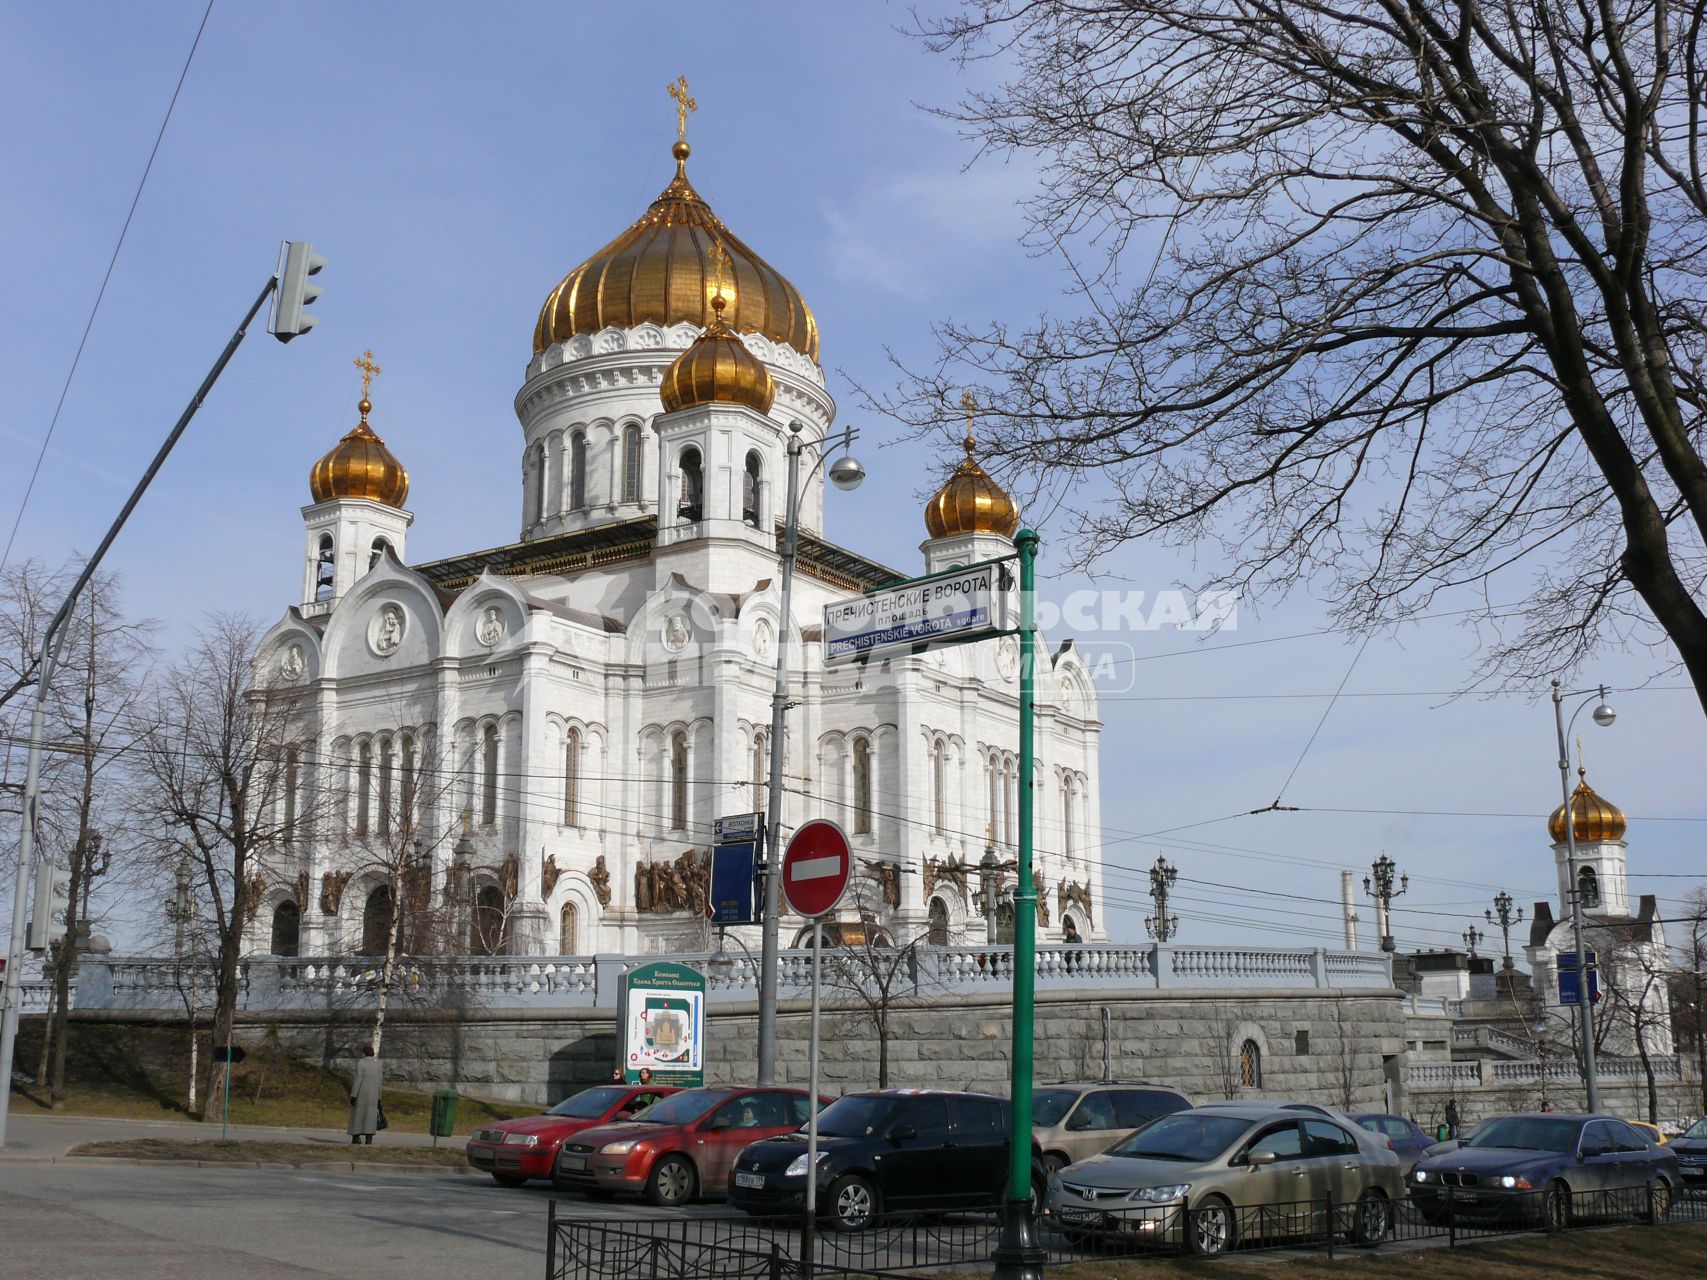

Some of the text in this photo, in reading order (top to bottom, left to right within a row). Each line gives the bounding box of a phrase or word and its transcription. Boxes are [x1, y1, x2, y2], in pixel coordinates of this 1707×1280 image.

[827, 576, 988, 625] ПРЕЧИСТЕНСКИЕ ВОРОТА
[878, 607, 929, 626] площадь
[830, 613, 985, 654] PRECHISTENSKIE VOROTA square
